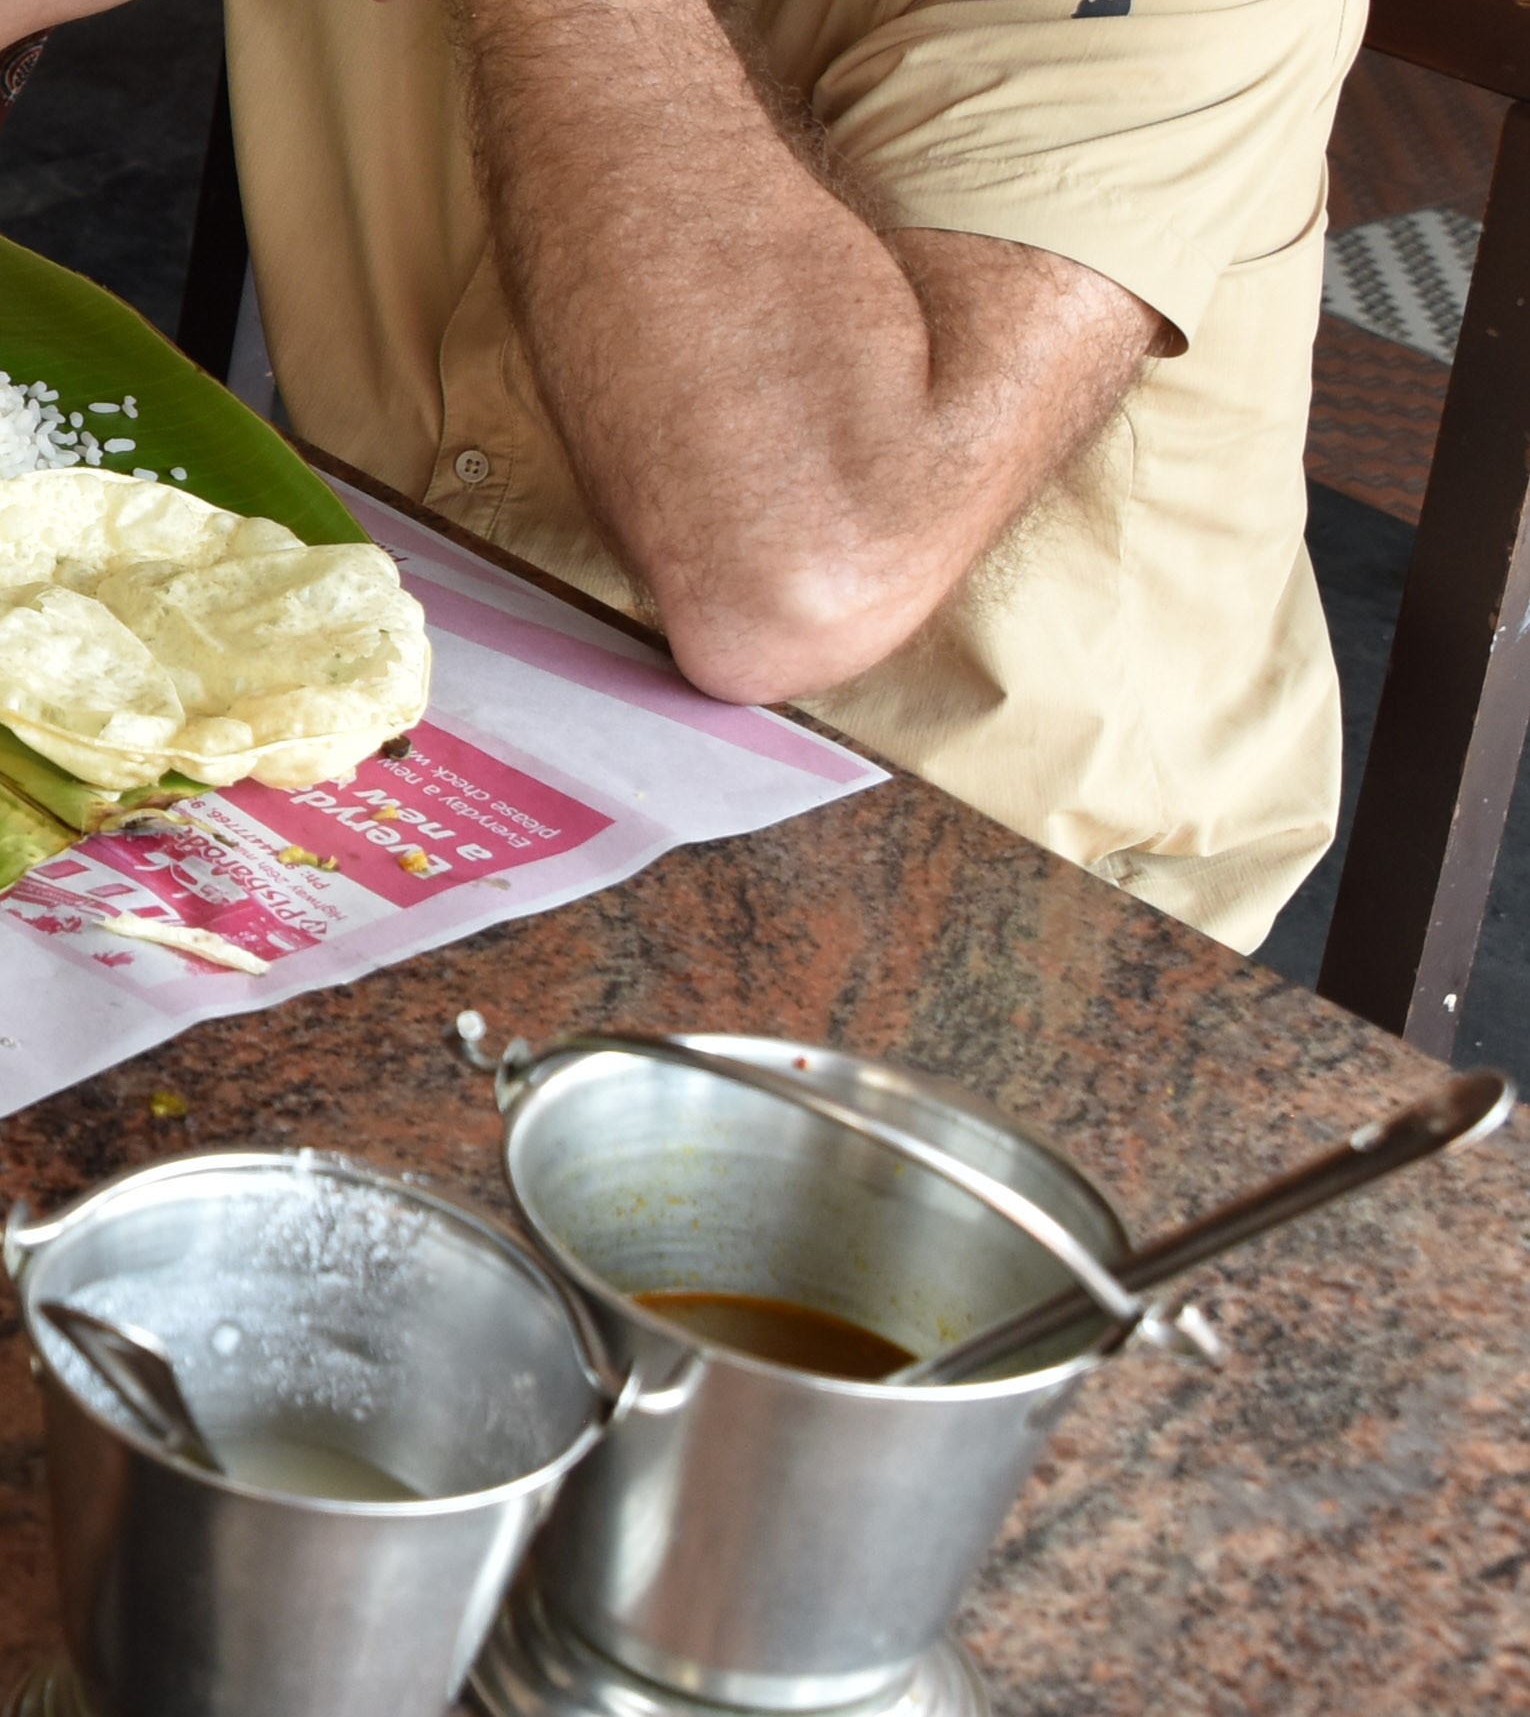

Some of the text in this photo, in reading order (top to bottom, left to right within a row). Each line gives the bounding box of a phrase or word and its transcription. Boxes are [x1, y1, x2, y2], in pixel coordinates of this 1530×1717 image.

[377, 758, 425, 784] new
[430, 765, 490, 802] check
[422, 784, 441, 796] a
[351, 788, 494, 861] a new
[438, 795, 533, 849] Everyday
[490, 800, 563, 840] please
[206, 809, 298, 871] 944477766,
[300, 871, 331, 891] Ph:
[292, 885, 348, 922] Highway
